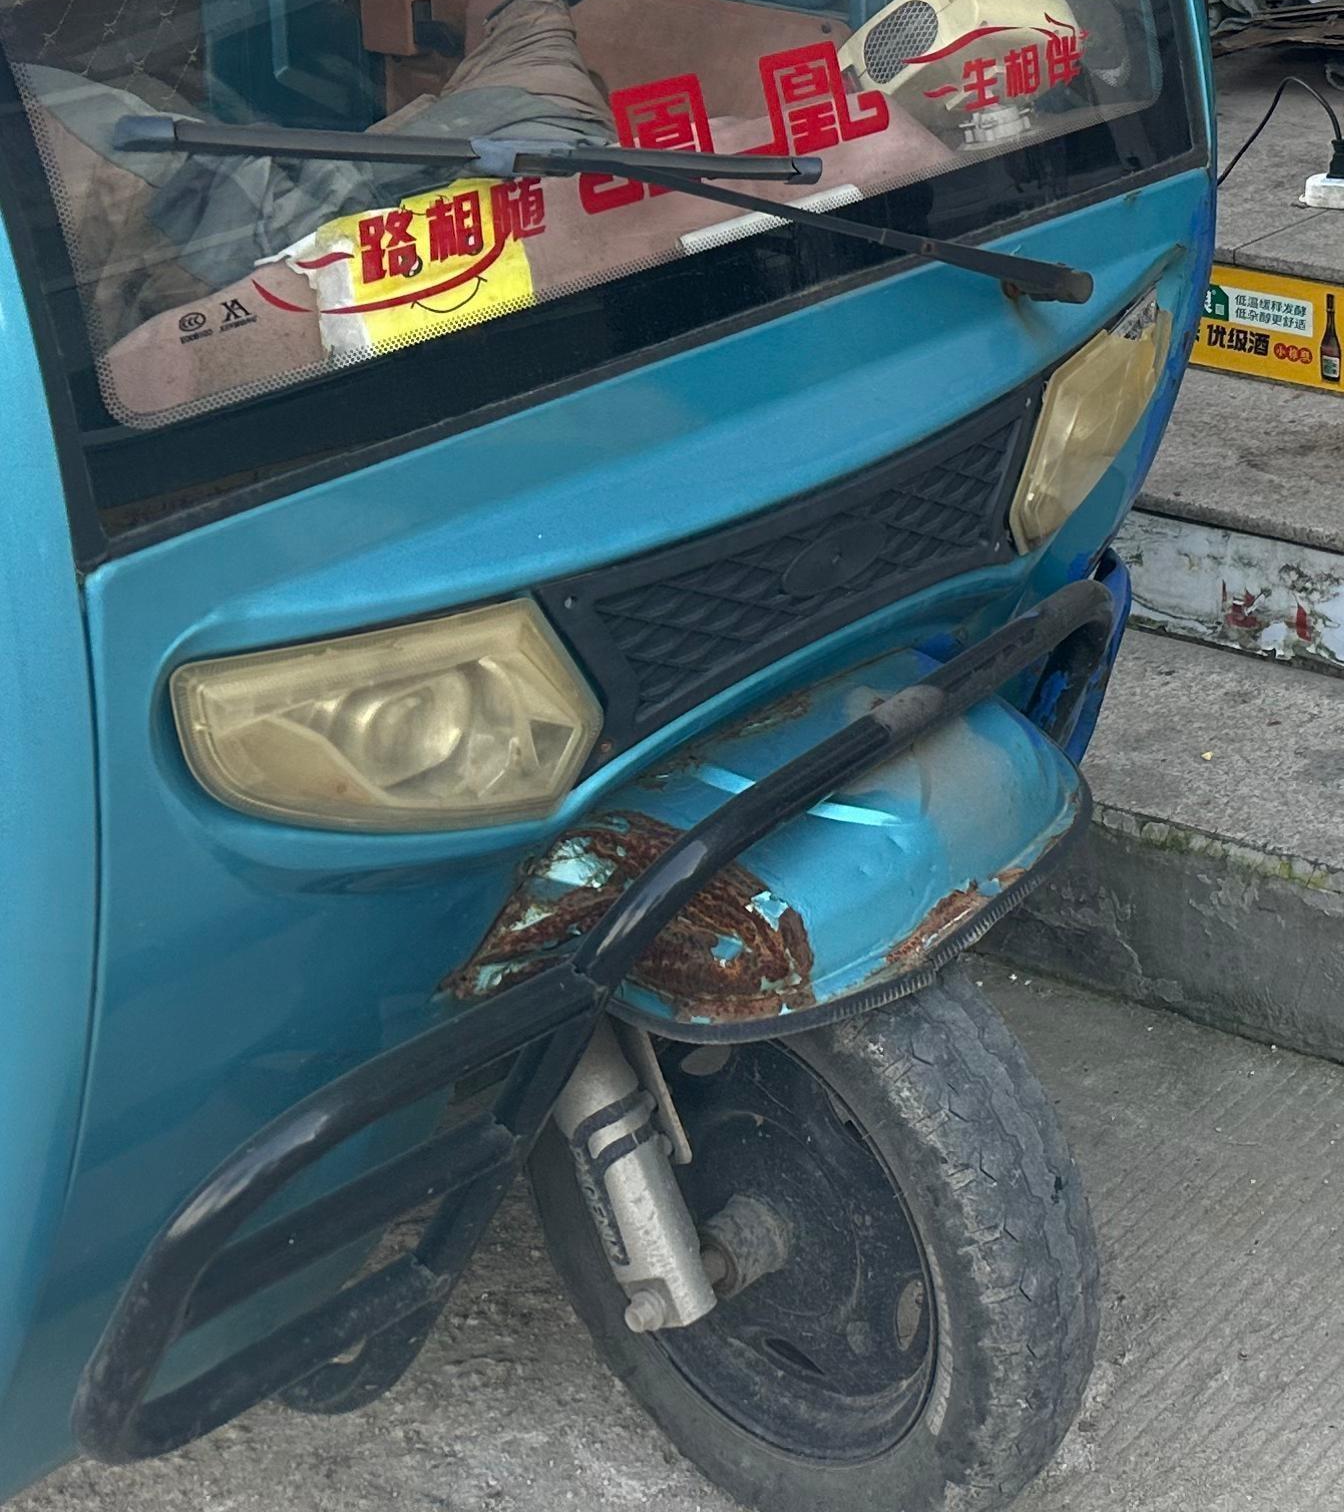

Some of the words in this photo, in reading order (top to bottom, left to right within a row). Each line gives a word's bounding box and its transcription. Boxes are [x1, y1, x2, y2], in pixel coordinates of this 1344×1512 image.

[923, 34, 1085, 112] 一生相伴
[296, 176, 546, 284] 一路相随
[1235, 294, 1308, 316] 低温缓释发酵
[1235, 307, 1307, 331] 低杂醇更舒适
[1206, 323, 1271, 356] 优级酒
